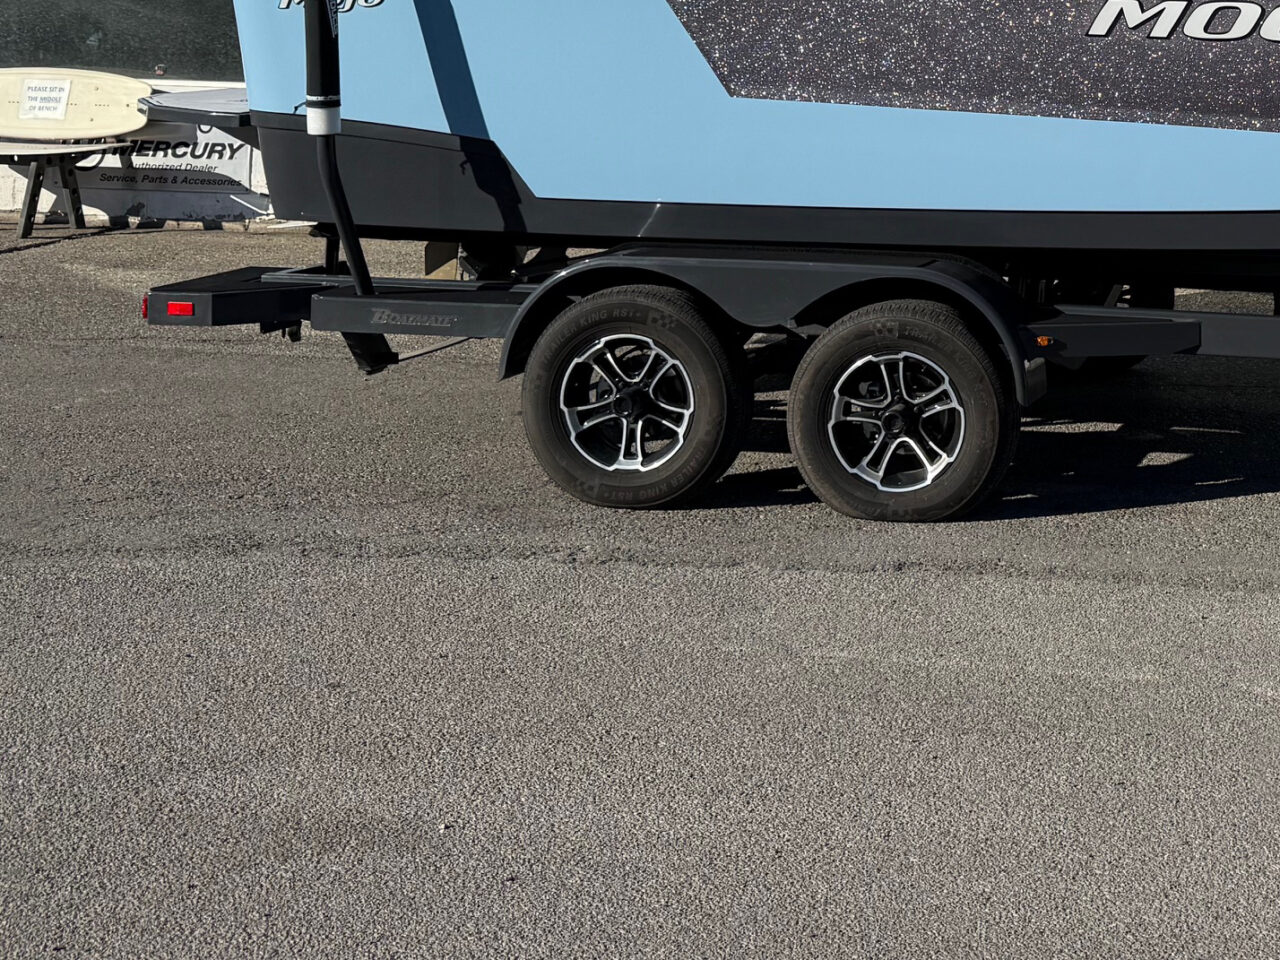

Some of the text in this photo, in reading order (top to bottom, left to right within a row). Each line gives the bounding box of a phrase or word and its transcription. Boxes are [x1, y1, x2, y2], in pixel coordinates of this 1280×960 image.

[111, 139, 247, 160] MERCURY
[127, 162, 219, 173] Authorized Dealer
[99, 173, 243, 187] Service, Parts & Accessories
